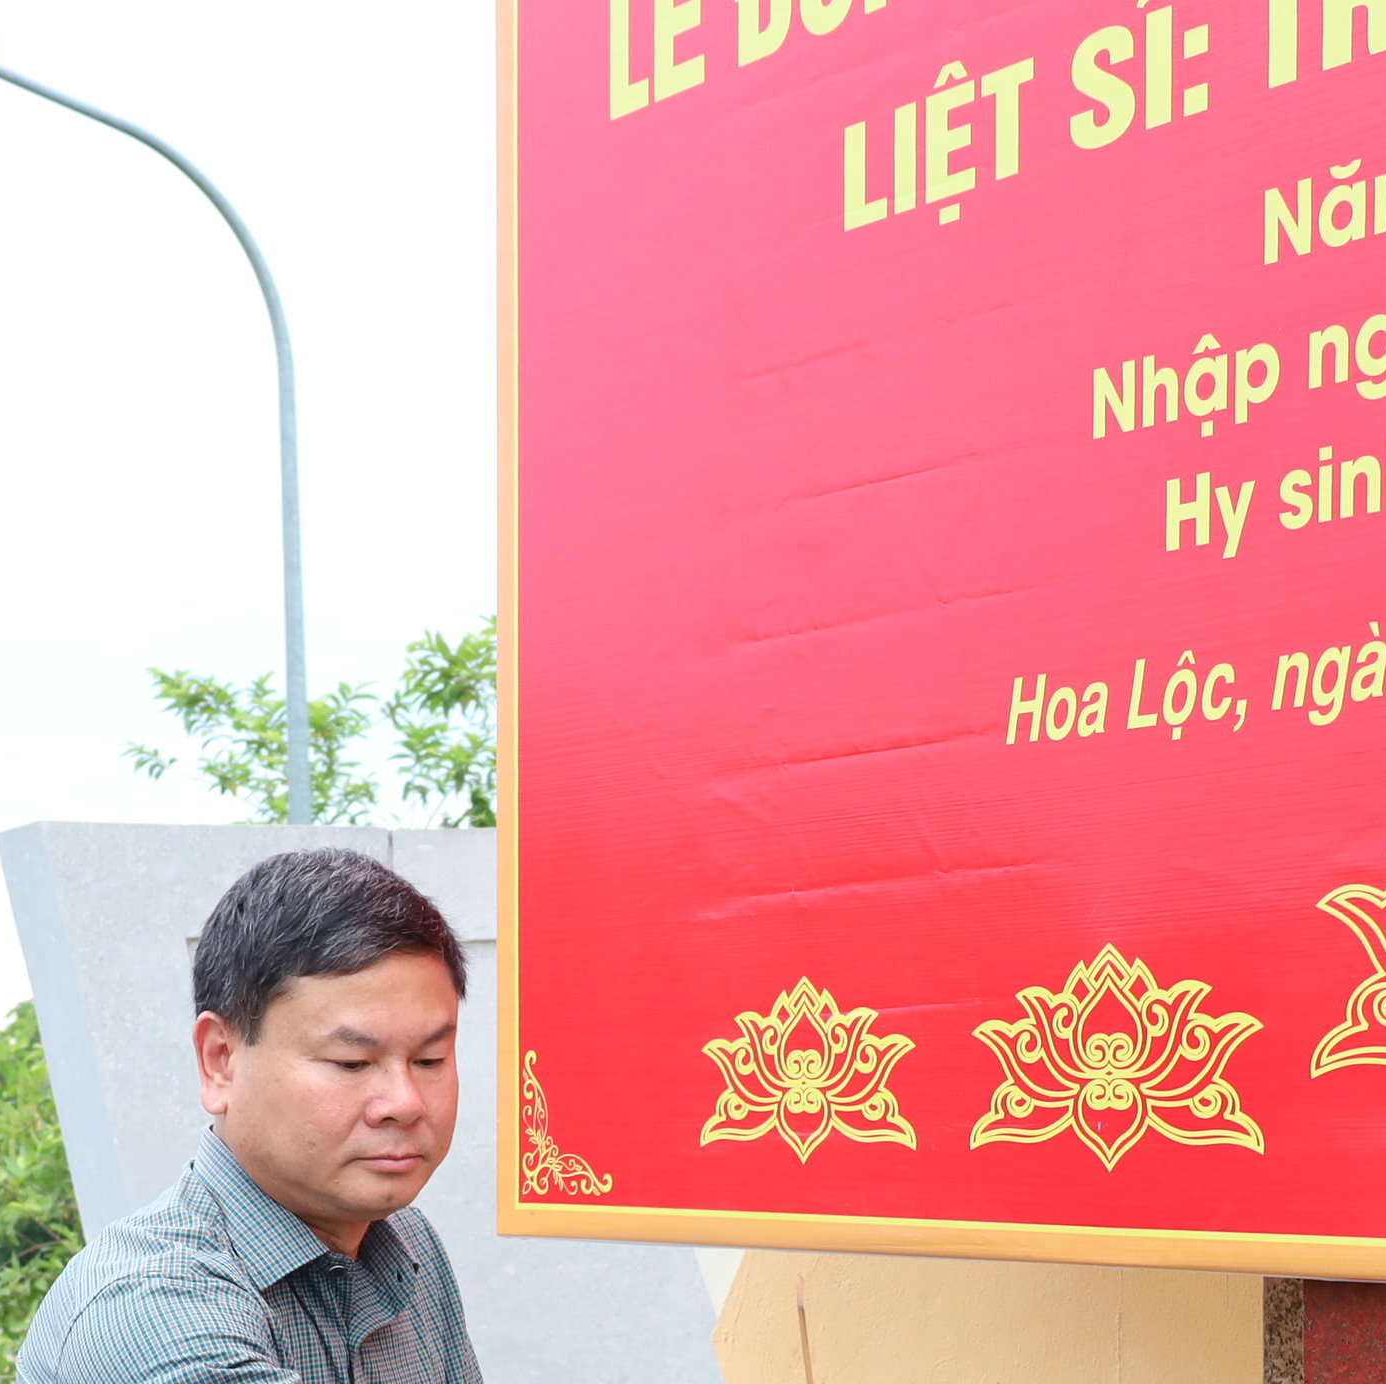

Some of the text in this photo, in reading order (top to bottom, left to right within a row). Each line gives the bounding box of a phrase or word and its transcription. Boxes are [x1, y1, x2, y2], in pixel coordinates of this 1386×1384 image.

[843, 57, 1035, 232] LIỆT
[1092, 333, 1280, 440] Nhập
[1165, 471, 1256, 559] Hy
[1006, 673, 1109, 745] Hoa
[1126, 650, 1248, 740] Lộc,
